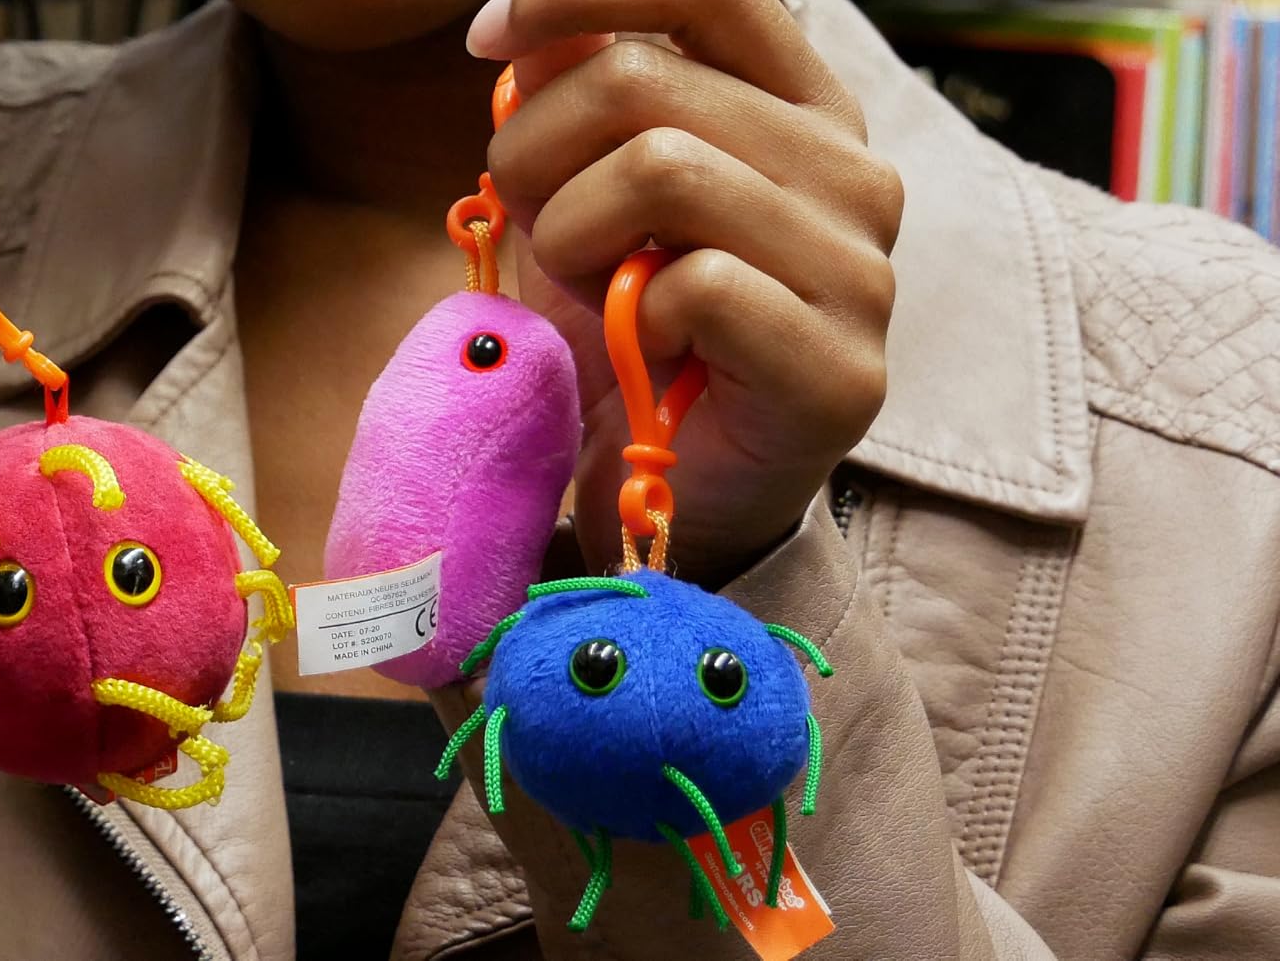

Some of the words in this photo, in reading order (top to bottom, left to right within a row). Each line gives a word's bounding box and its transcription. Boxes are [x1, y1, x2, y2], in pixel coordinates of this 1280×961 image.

[374, 583, 399, 594] NEUFS
[368, 600, 394, 614] FIBRES
[395, 598, 406, 607] DE
[359, 625, 381, 635] 07-20
[332, 641, 349, 650] LOT
[360, 632, 392, 646] S20X070
[334, 648, 359, 661] MADE
[361, 648, 369, 656] IN
[370, 642, 394, 654] CHINA
